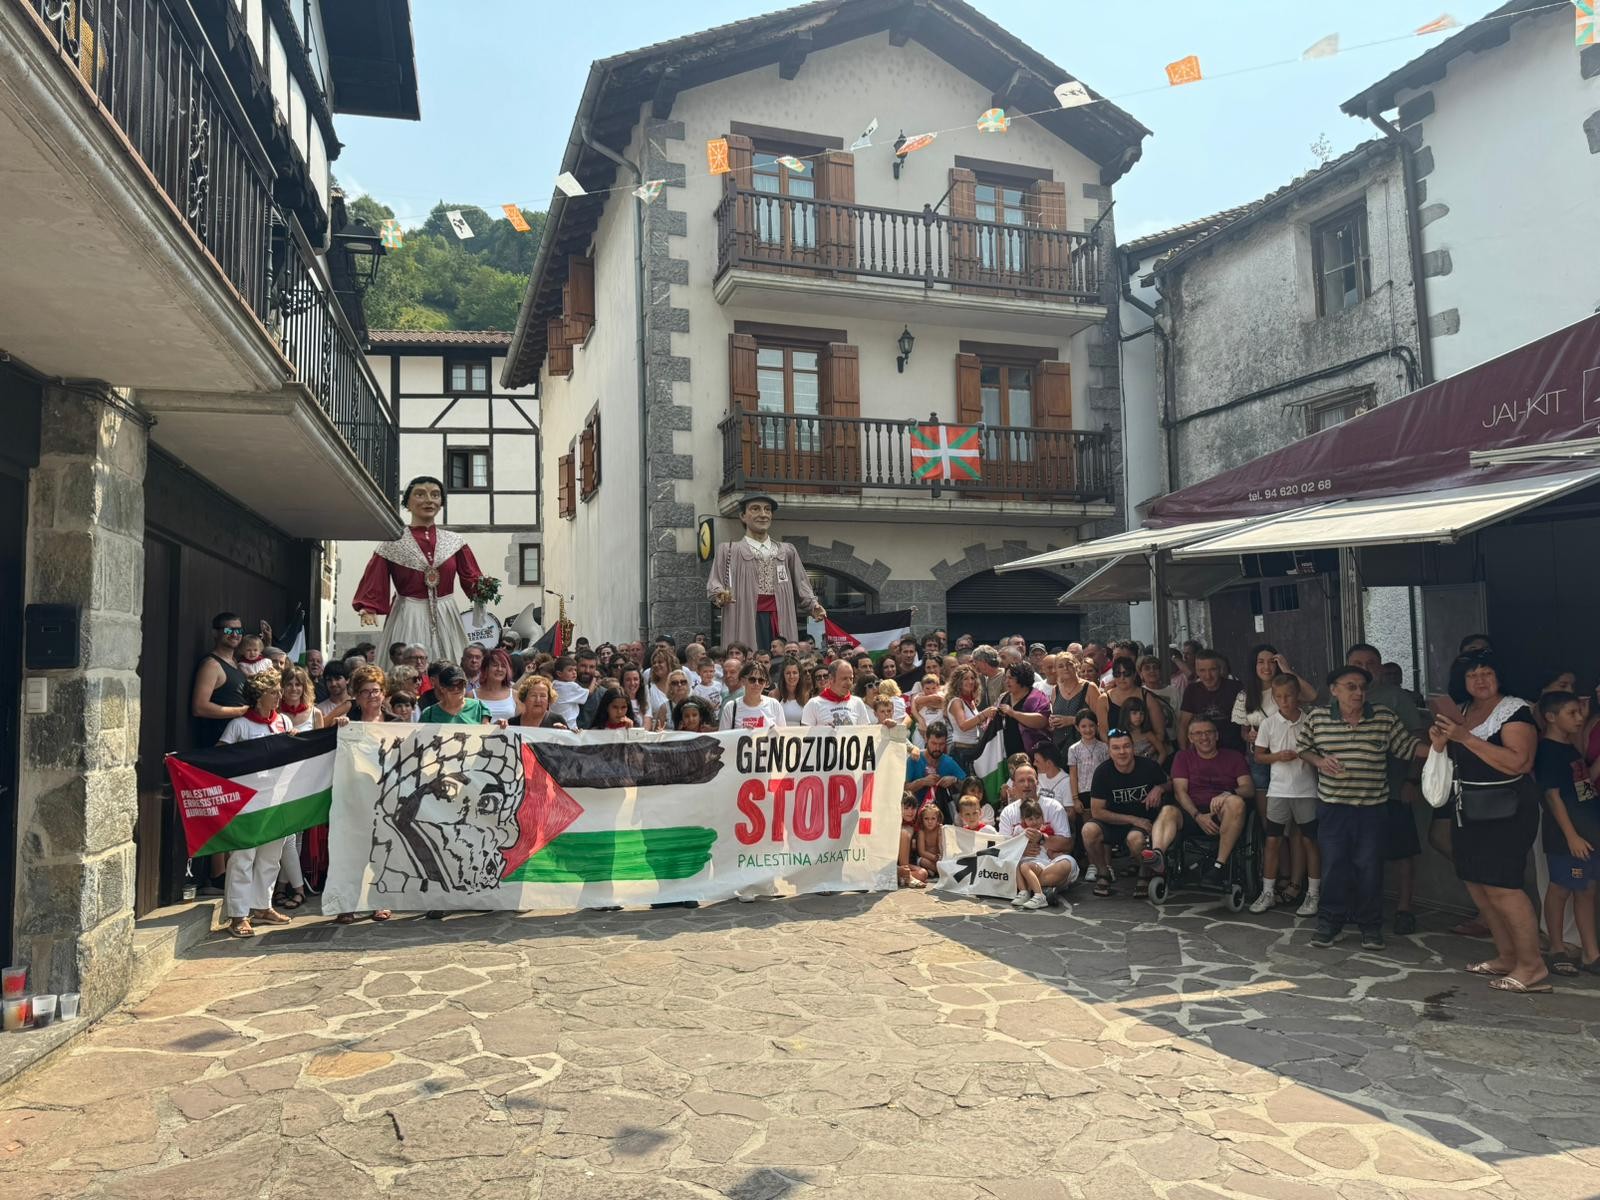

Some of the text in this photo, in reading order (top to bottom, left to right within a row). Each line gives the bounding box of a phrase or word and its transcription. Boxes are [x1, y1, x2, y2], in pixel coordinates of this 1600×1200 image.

[1482, 388, 1567, 428] JAI-KIT
[1248, 479, 1332, 502] tel. 94 620 02 68
[736, 735, 876, 774] GENOZIDIOA
[180, 785, 223, 799] PALESTINAR
[735, 772, 874, 845] STOP!
[737, 849, 867, 868] PALESTINA ASKATU!
[978, 868, 1009, 881] etxera
